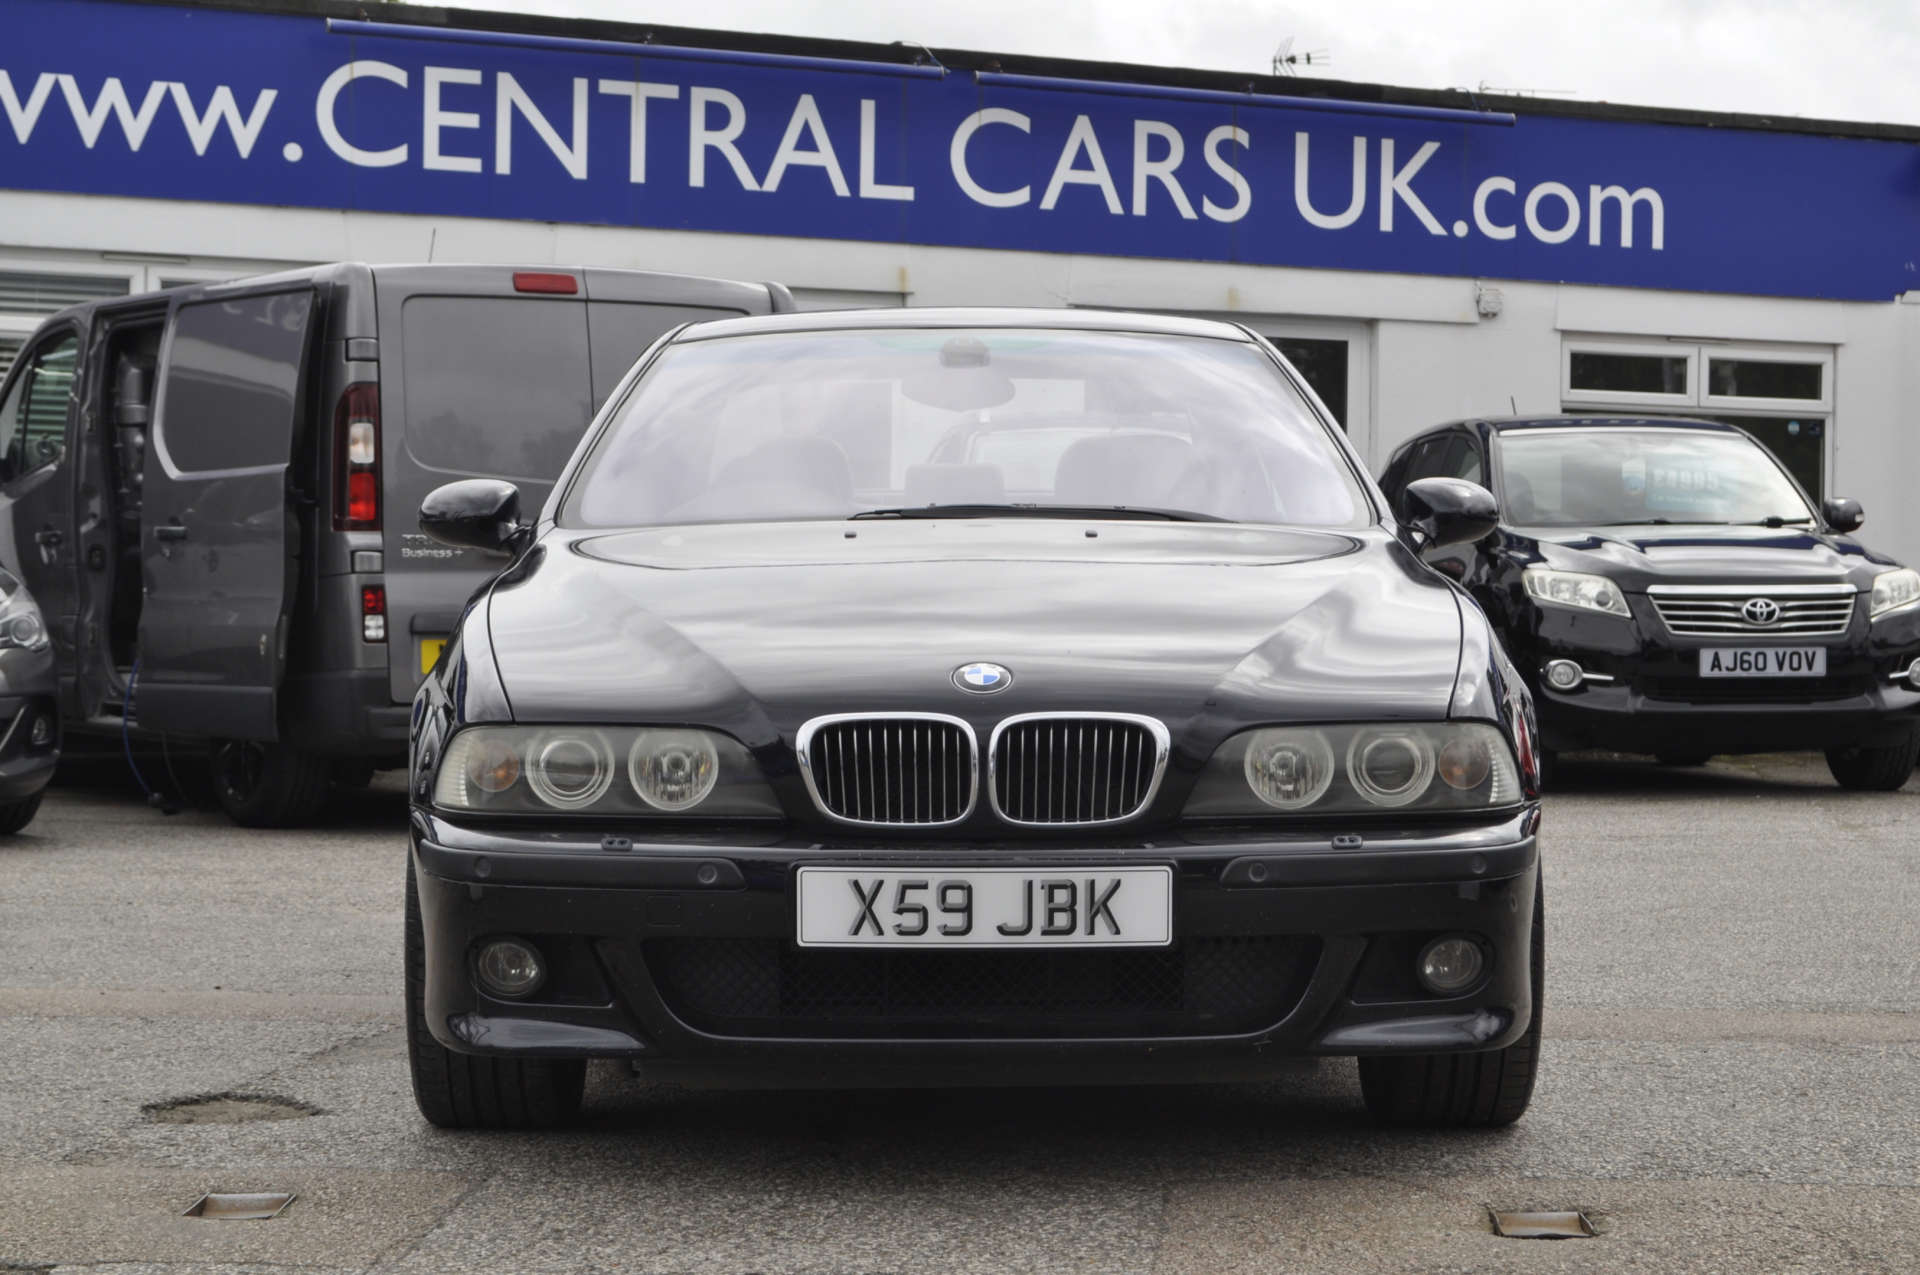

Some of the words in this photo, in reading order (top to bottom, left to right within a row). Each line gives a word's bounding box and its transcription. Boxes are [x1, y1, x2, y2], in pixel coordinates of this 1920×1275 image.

[950, 107, 1252, 223] CARS
[1294, 132, 1665, 250] UK.com
[1710, 650, 1768, 673] AJ60
[1774, 650, 1817, 672] VOV
[848, 878, 974, 937] X59
[995, 878, 1122, 937] JBK
